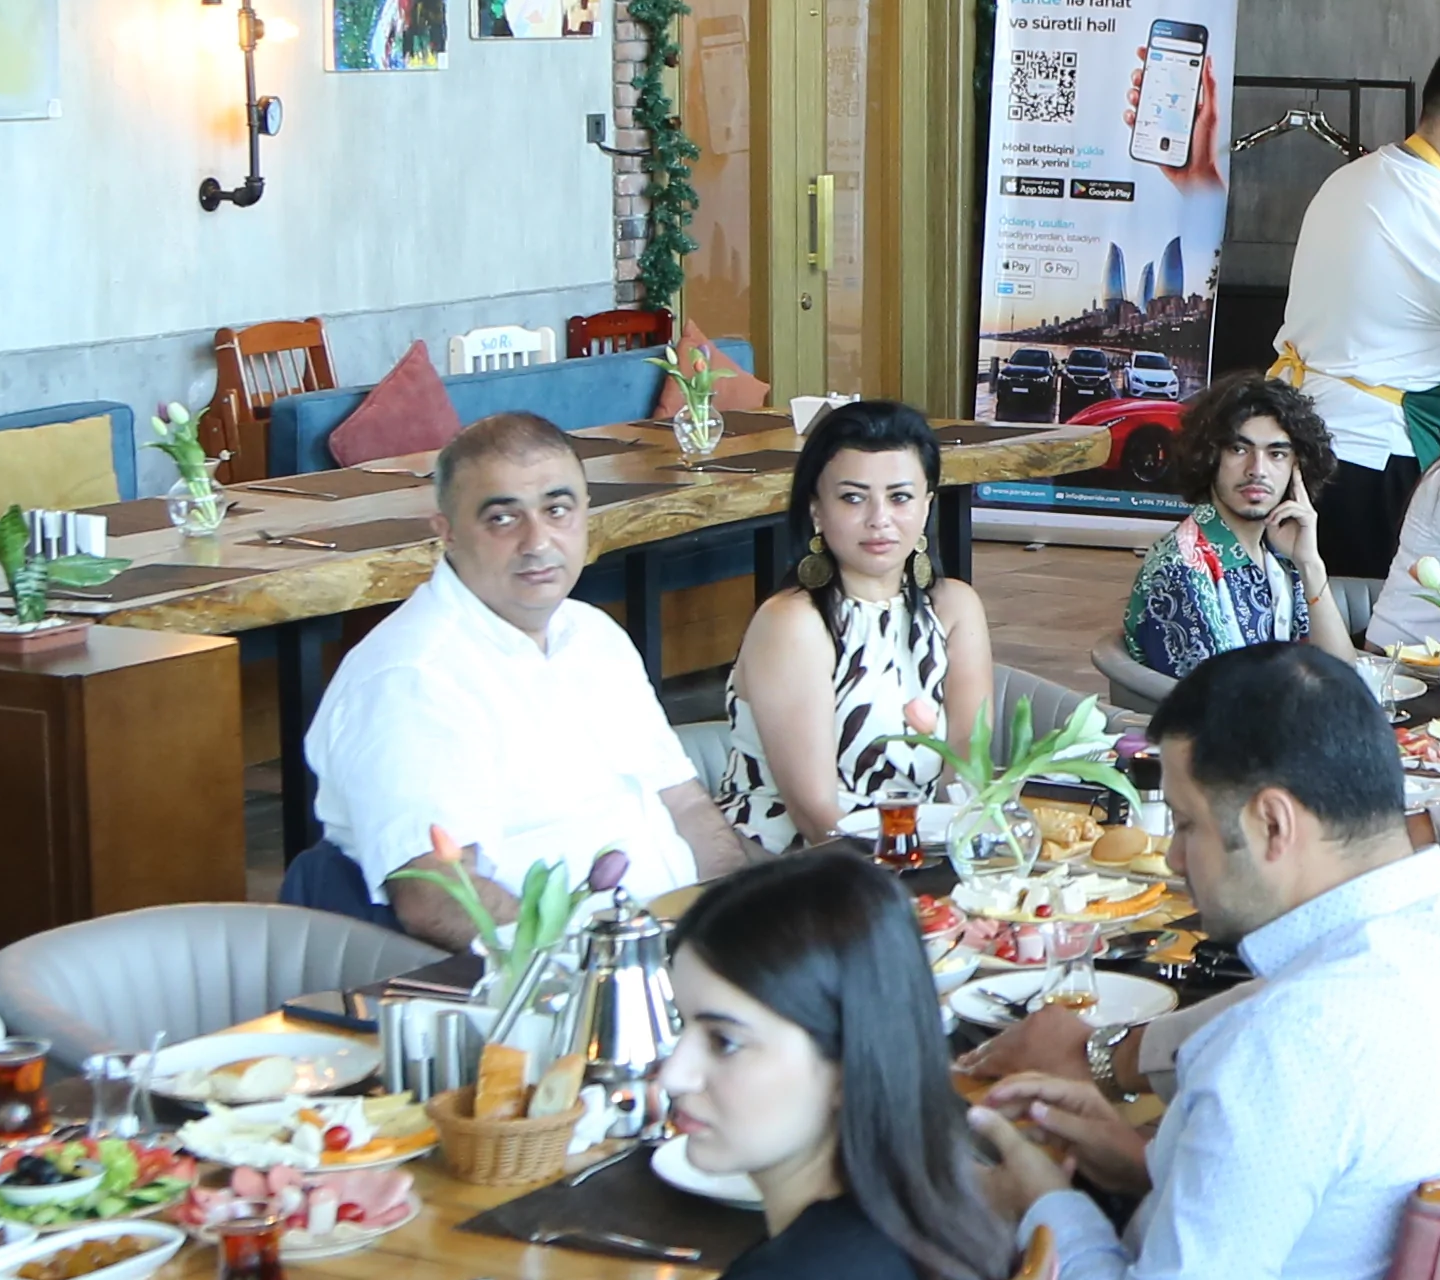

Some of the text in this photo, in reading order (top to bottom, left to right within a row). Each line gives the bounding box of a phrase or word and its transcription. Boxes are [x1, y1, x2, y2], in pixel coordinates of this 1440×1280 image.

[1010, 17, 1116, 33] və sürətli həll
[1002, 142, 1030, 152] Mobil
[1016, 157, 1039, 167] park
[1041, 157, 1069, 168] yerini
[1020, 185, 1059, 195] App Store
[1088, 187, 1131, 199] Google Play
[1012, 261, 1030, 273] Pay
[1056, 263, 1073, 275] Pay
